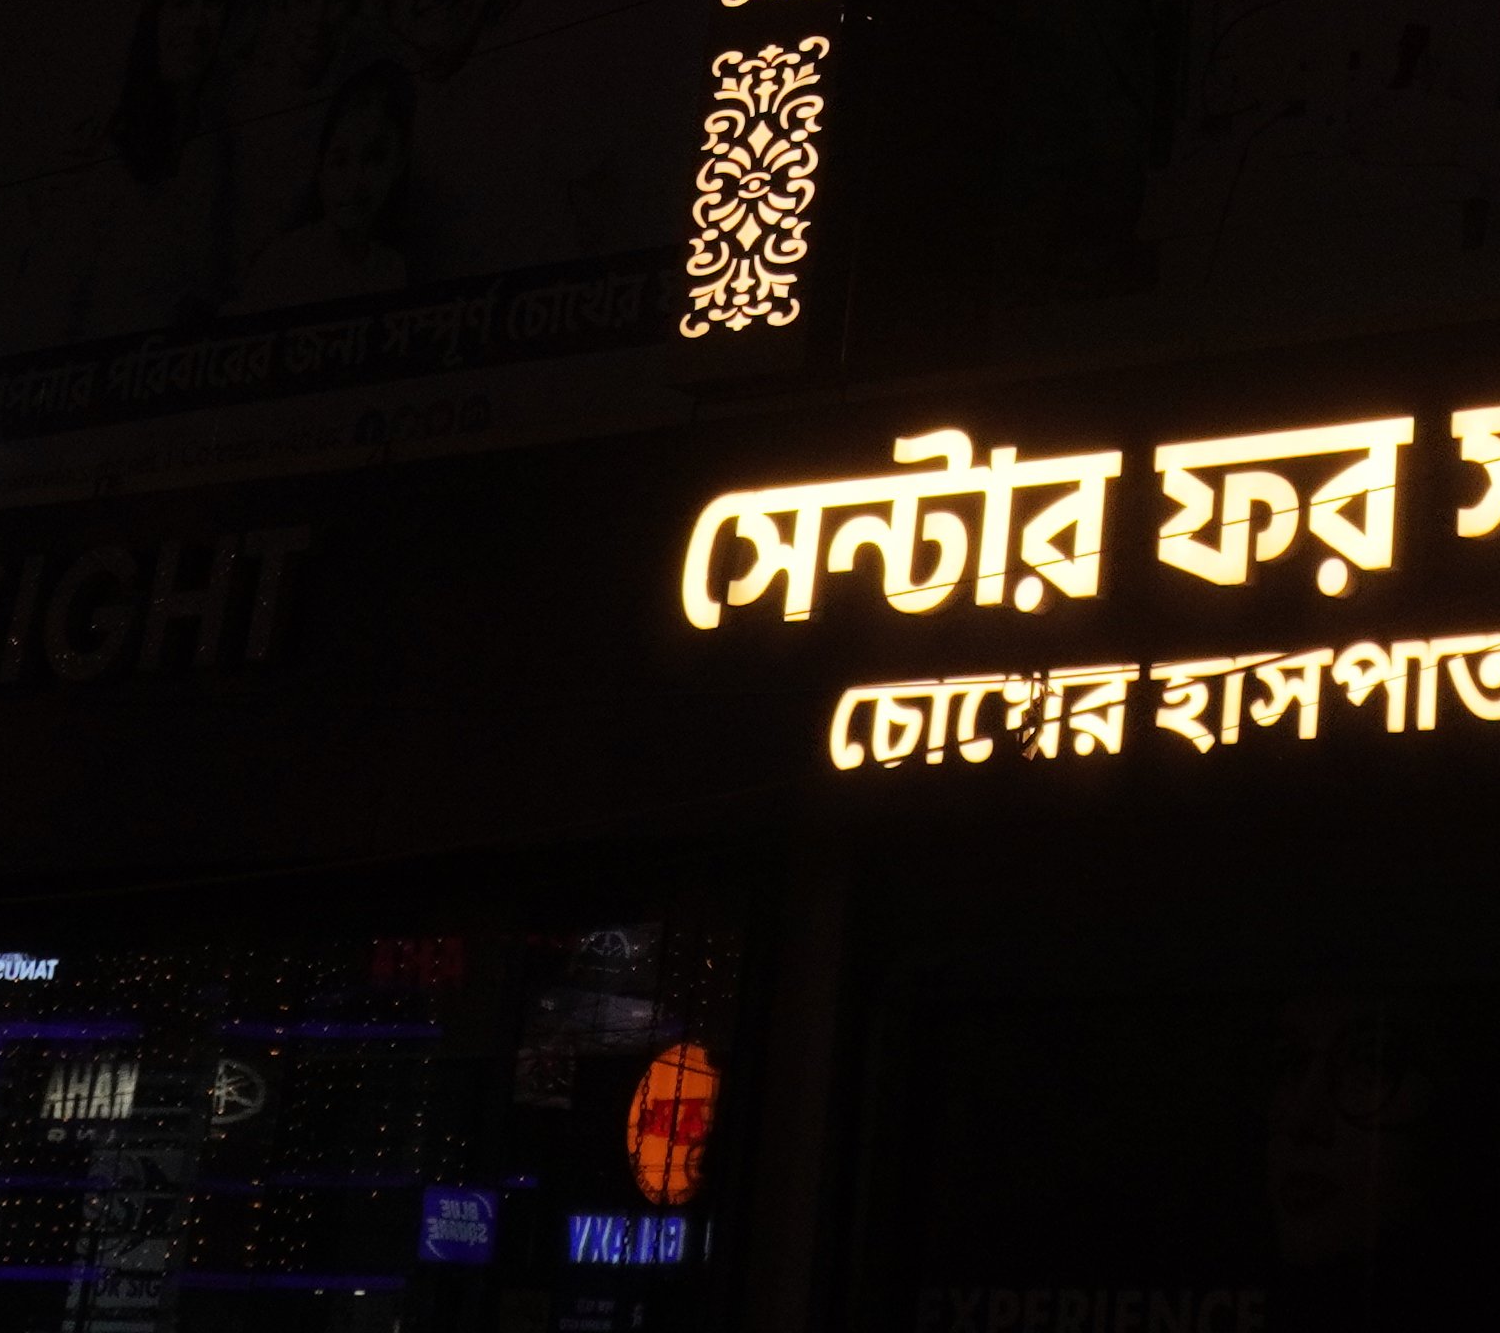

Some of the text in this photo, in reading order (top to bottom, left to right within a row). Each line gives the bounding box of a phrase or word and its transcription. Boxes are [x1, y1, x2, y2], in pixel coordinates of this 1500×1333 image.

[682, 427, 1123, 630] সেন্টার
[1153, 415, 1415, 597] ফর
[829, 663, 1141, 771] চোখের
[915, 1287, 1268, 1333] EXPERIENCE
